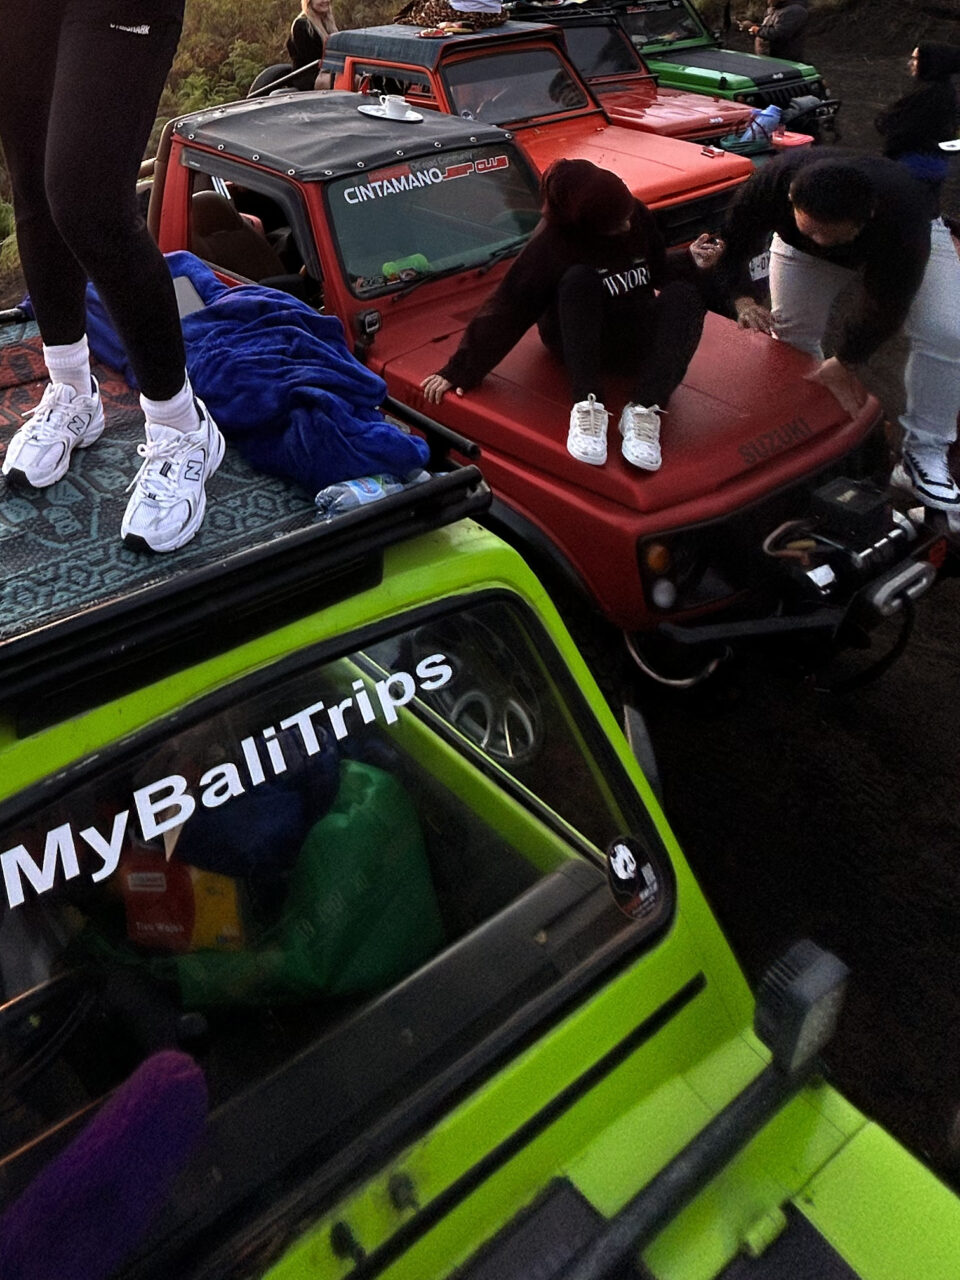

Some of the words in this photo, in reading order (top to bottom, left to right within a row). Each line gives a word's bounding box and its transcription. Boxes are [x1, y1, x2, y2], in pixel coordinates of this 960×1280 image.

[602, 265, 651, 297] WYOR
[737, 416, 812, 465] SUZUKI
[0, 652, 453, 909] MyBaliTrips
